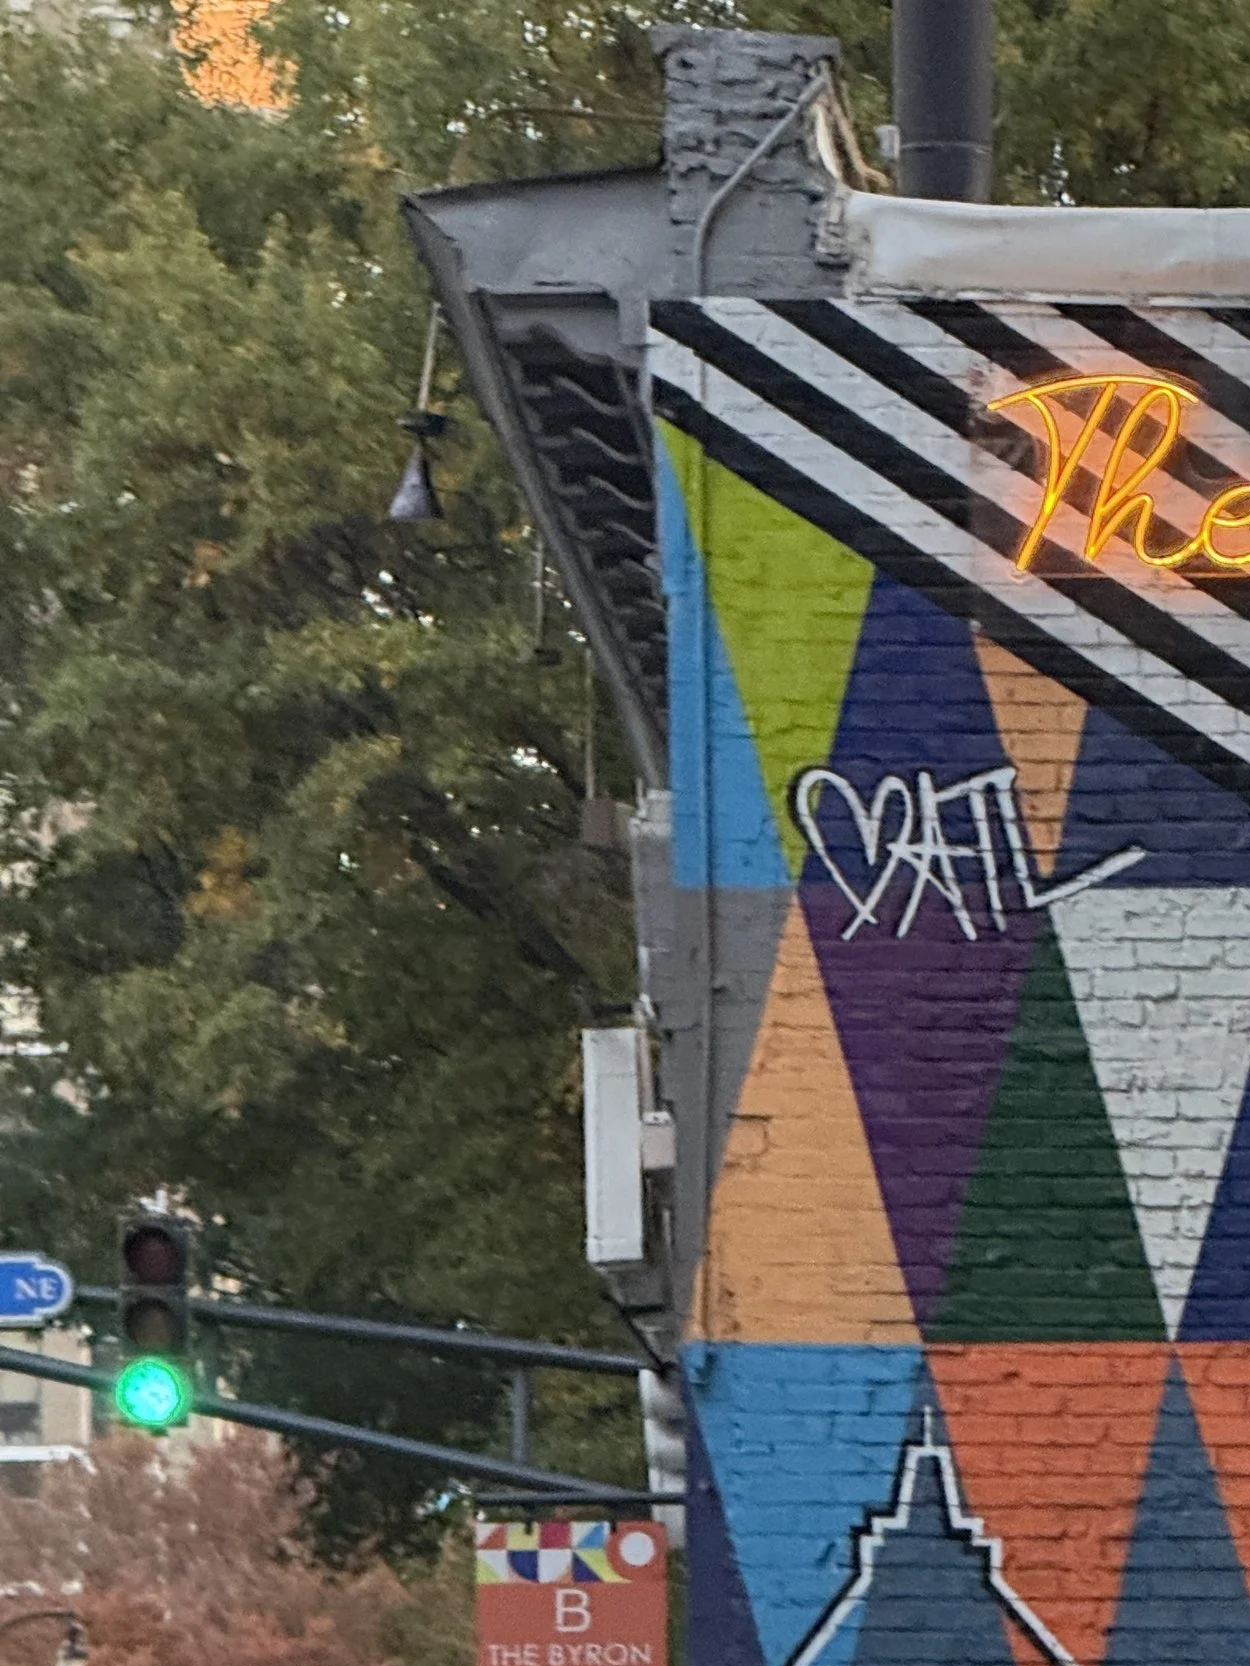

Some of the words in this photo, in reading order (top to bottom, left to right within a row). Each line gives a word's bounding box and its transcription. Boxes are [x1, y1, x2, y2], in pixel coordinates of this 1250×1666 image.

[14, 1277, 58, 1300] NE
[554, 1588, 592, 1633] B
[487, 1643, 542, 1666] THE
[547, 1642, 653, 1666] BYRON
